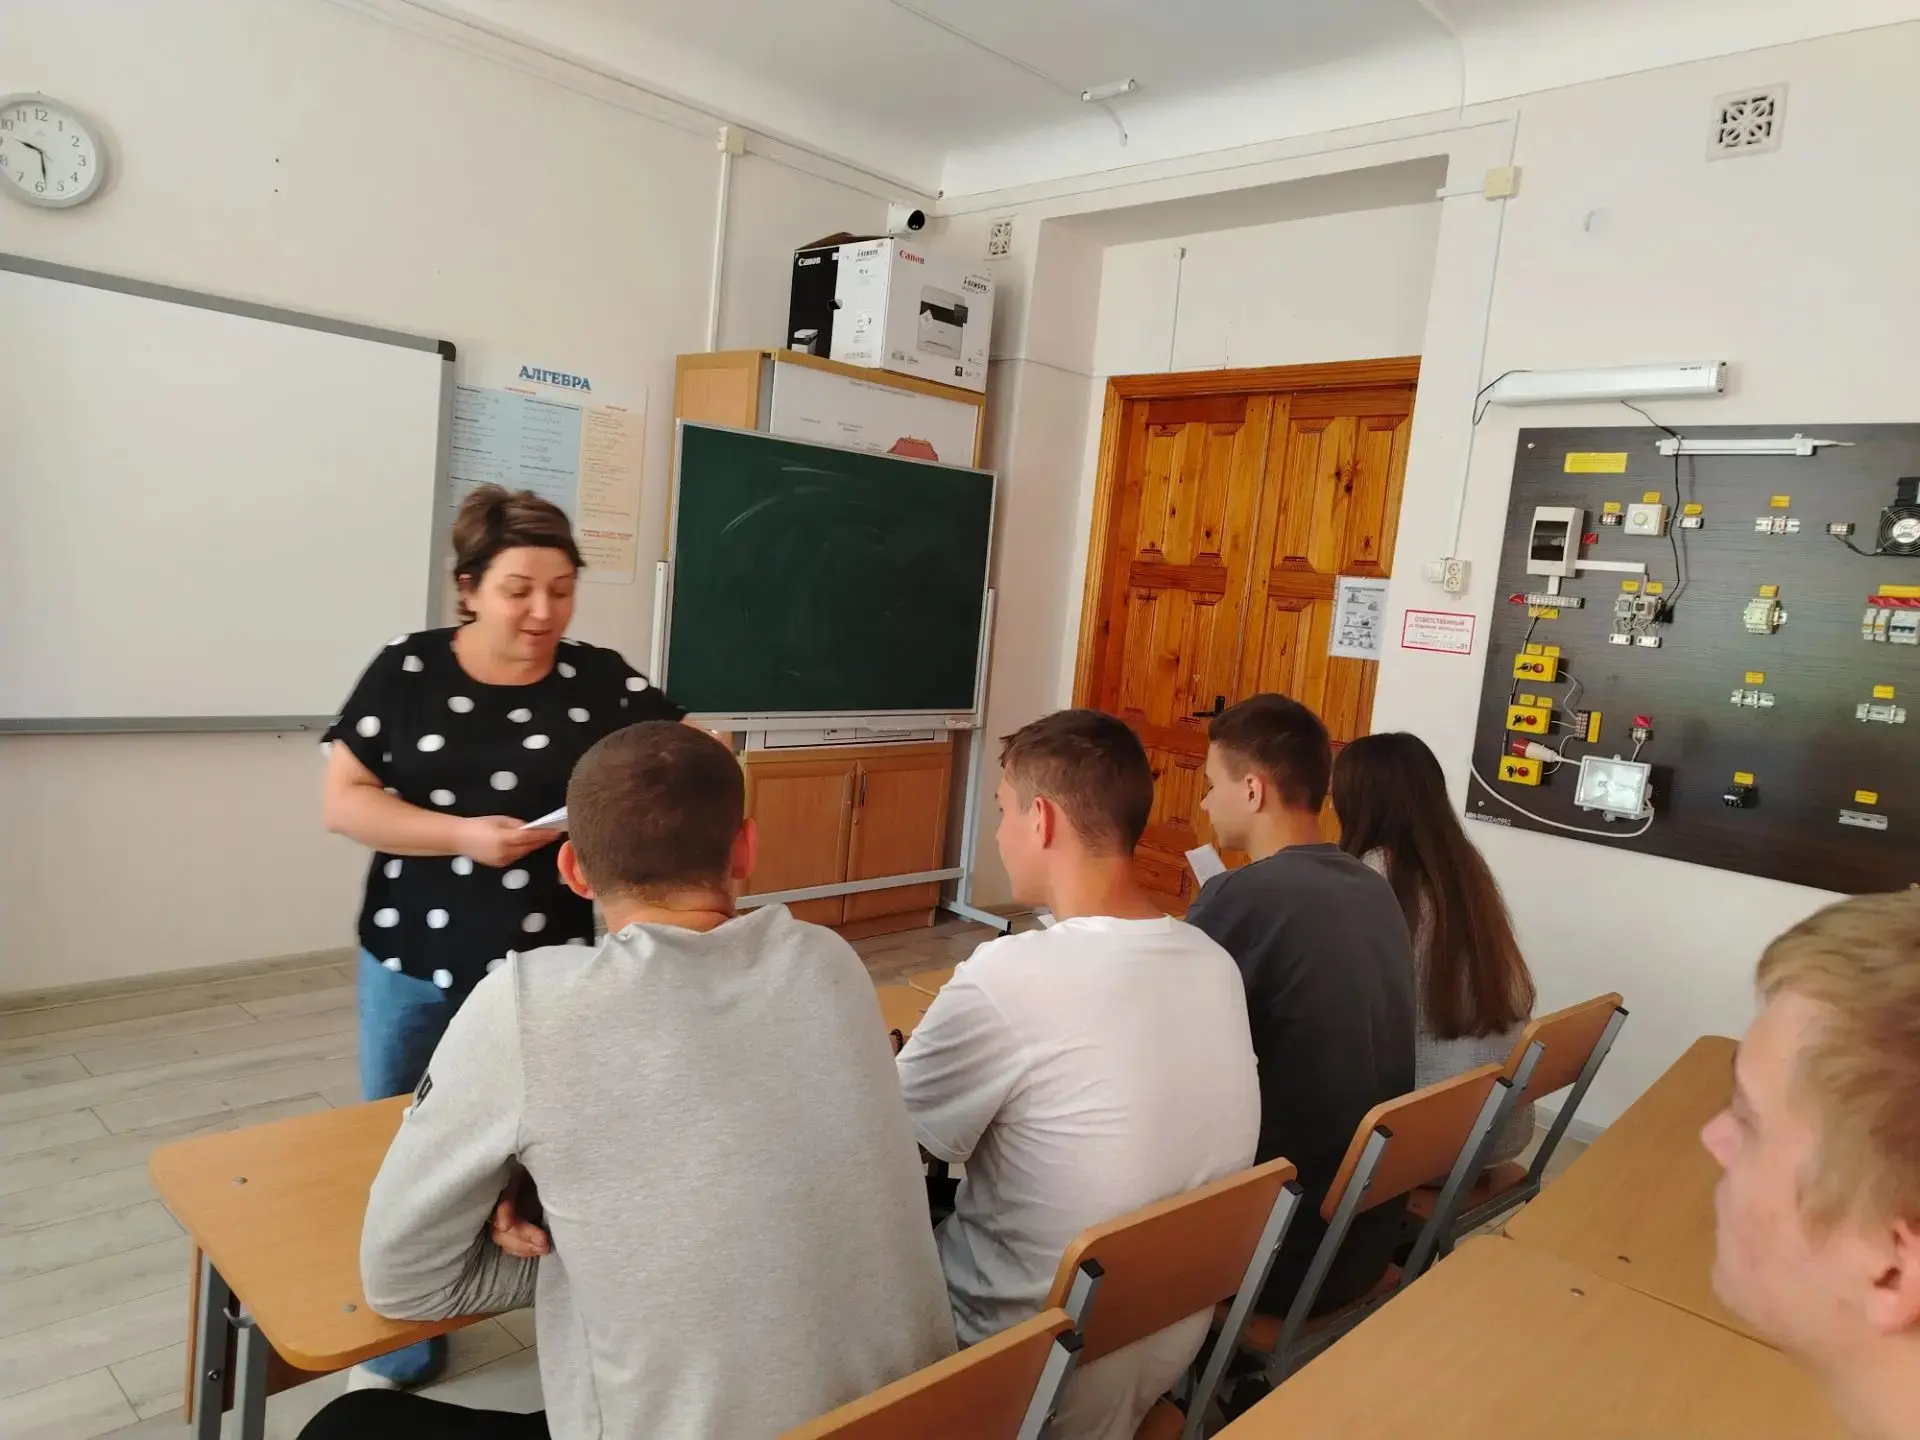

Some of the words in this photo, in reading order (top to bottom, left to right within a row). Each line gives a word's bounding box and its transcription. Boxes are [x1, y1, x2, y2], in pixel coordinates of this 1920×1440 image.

[16, 109, 27, 123] 11
[34, 108, 49, 122] 12
[1, 118, 14, 131] 10
[71, 135, 80, 148] 2
[77, 154, 87, 167] 3
[16, 170, 25, 183] 7
[70, 171, 79, 183] 4
[35, 180, 45, 193] 6
[55, 180, 65, 192] 5
[798, 257, 821, 266] Canon
[899, 248, 925, 265] Canon
[518, 365, 592, 391] АЛГЕБРА
